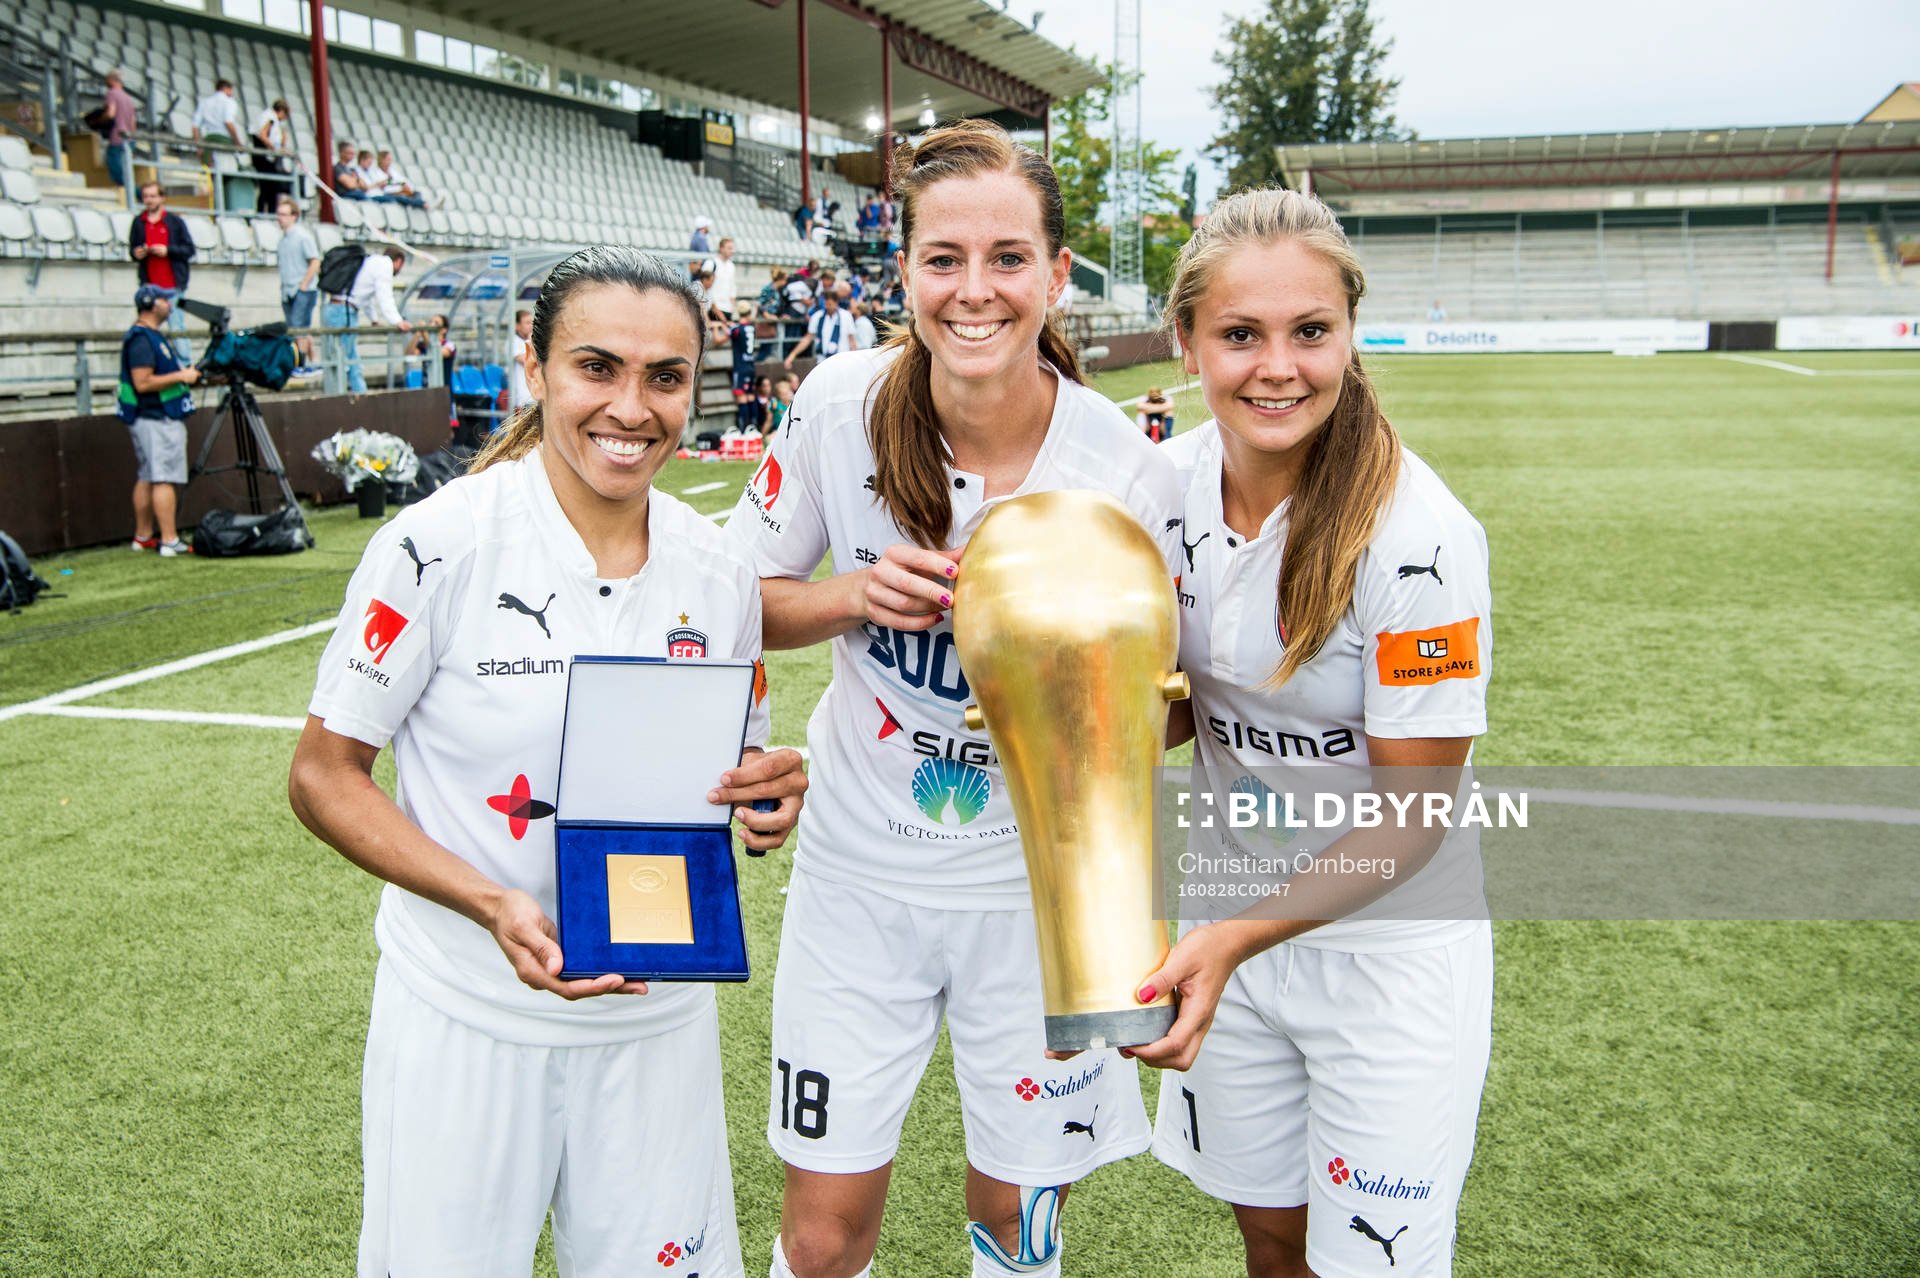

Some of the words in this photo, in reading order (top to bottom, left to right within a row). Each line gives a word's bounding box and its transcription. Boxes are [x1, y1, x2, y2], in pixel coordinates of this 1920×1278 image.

[1426, 331, 1498, 345] Deloitte
[477, 656, 564, 676] stadium
[1393, 667, 1433, 679] STORE
[1435, 665, 1443, 676] &
[1445, 660, 1474, 672] SAVE
[912, 730, 999, 767] SIG
[887, 819, 971, 840] VICTORIA
[777, 1057, 831, 1140] 18
[1181, 1085, 1201, 1154] 1
[1348, 1168, 1431, 1200] Salubrin
